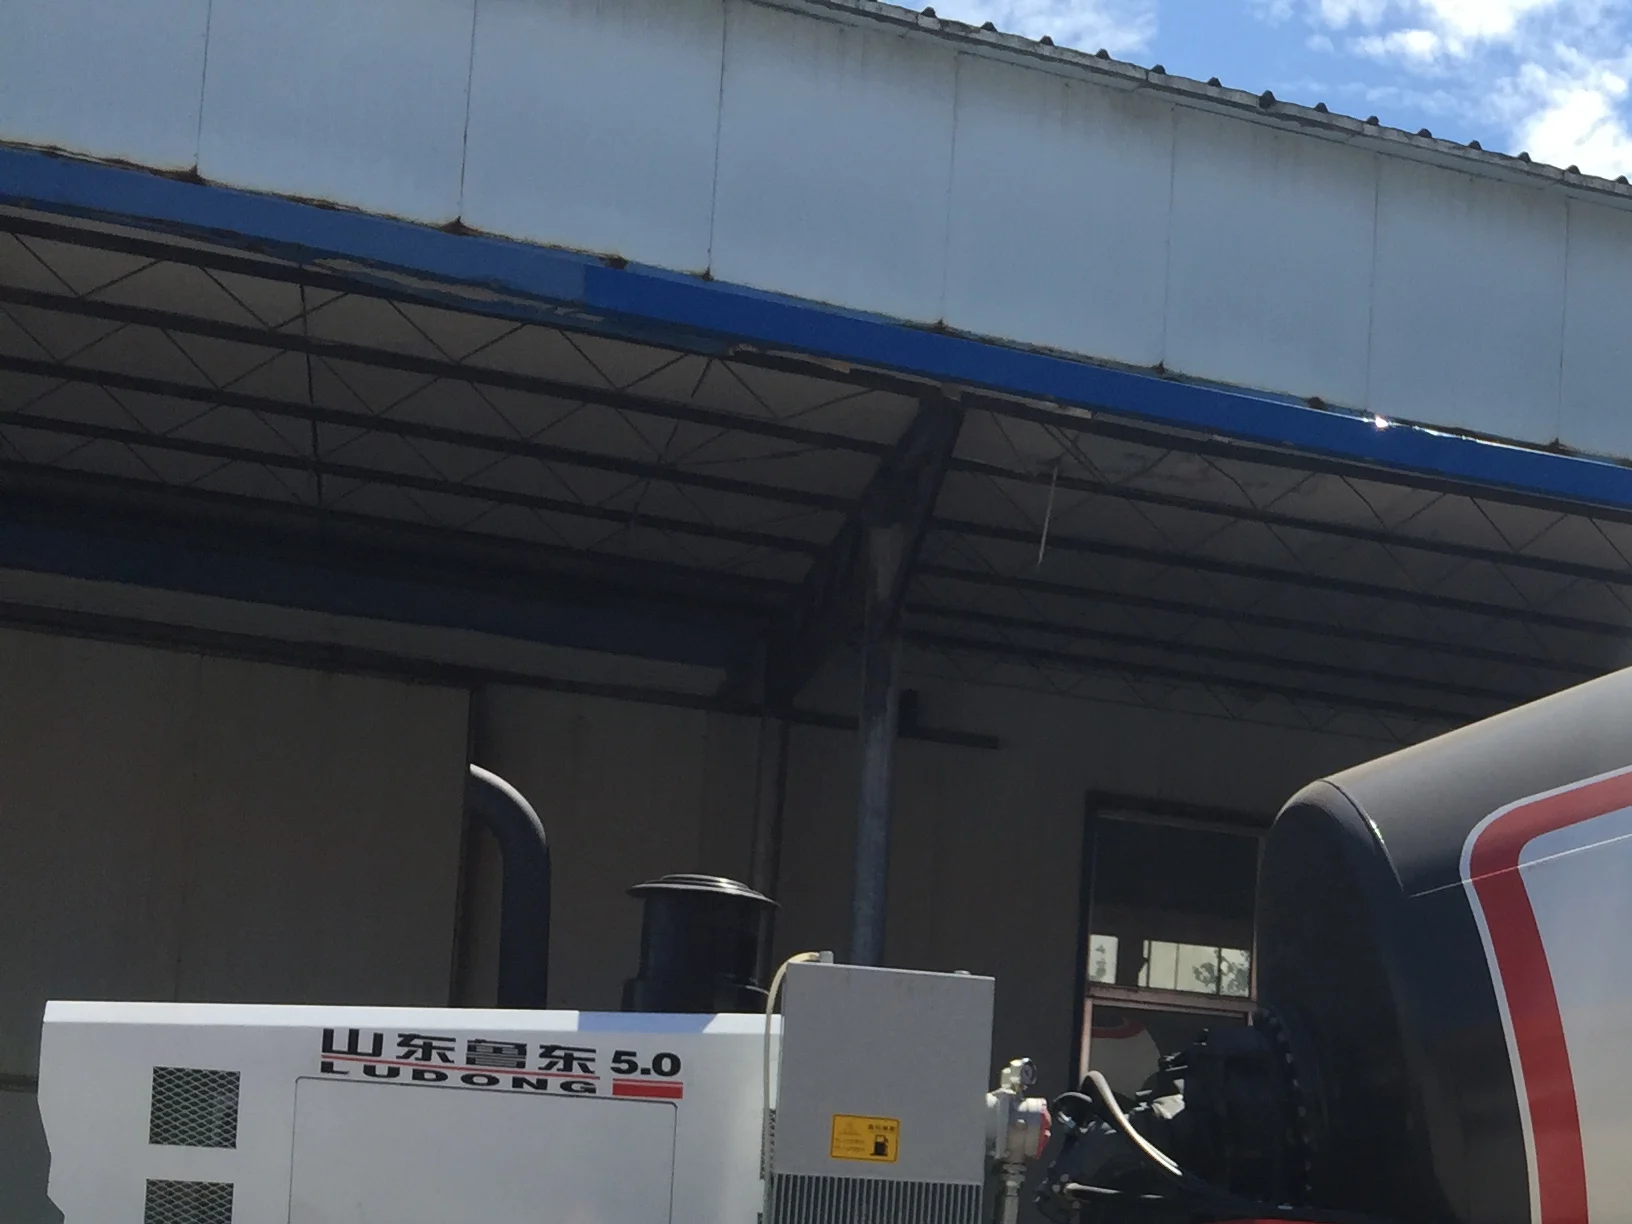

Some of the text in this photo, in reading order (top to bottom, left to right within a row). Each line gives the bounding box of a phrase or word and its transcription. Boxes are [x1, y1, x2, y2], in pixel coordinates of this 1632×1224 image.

[321, 1028, 682, 1077] 山东鲁东 5.0
[320, 1061, 597, 1094] LUDONG
